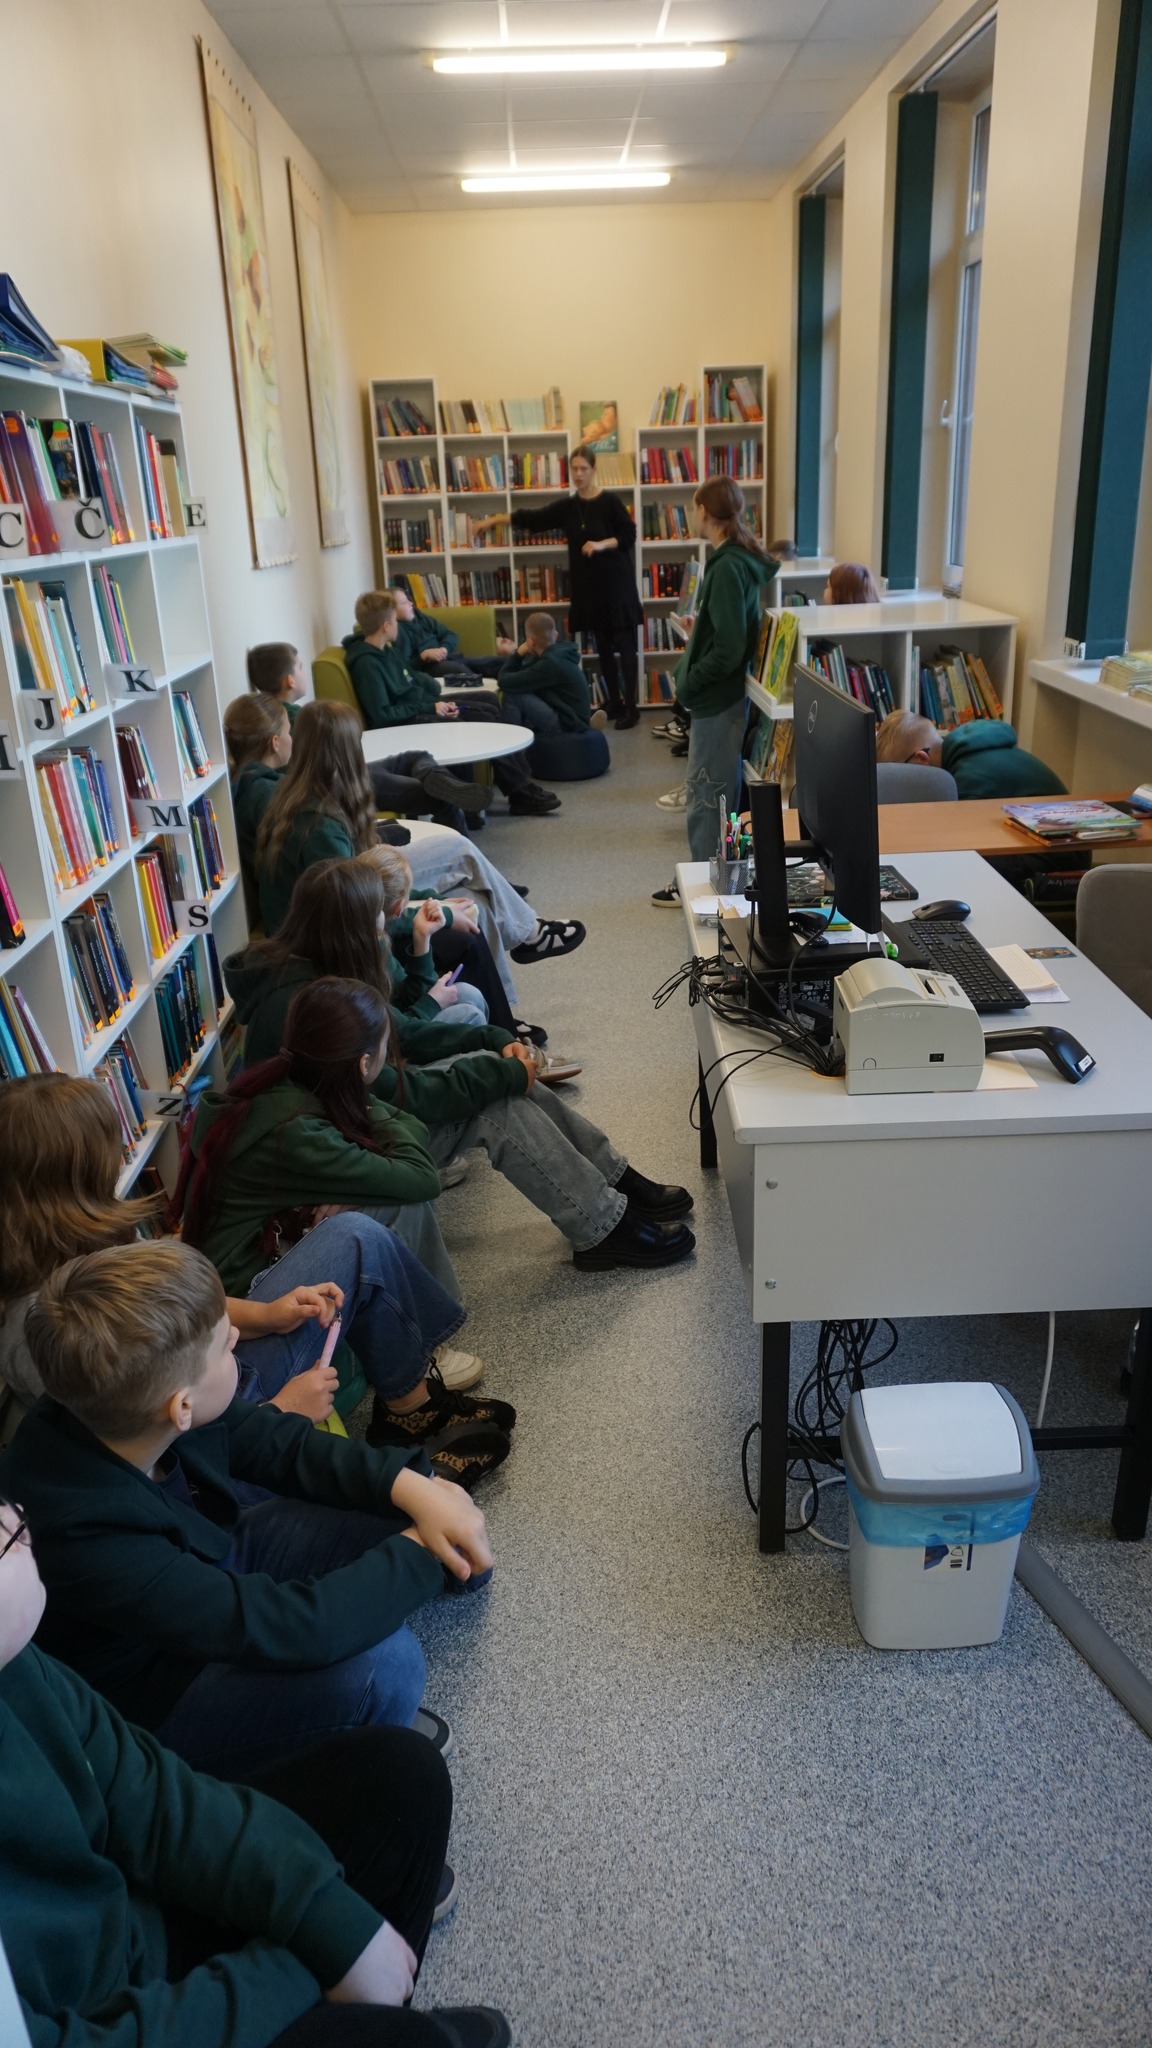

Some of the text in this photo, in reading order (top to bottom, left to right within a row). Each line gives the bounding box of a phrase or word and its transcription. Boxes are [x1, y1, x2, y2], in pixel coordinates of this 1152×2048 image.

[75, 498, 105, 539] Č
[183, 504, 206, 527] E
[0, 511, 24, 548] C
[120, 669, 157, 692] K
[34, 697, 55, 731] J
[147, 805, 186, 827] M
[188, 904, 209, 928] S
[154, 1097, 183, 1117] Z
